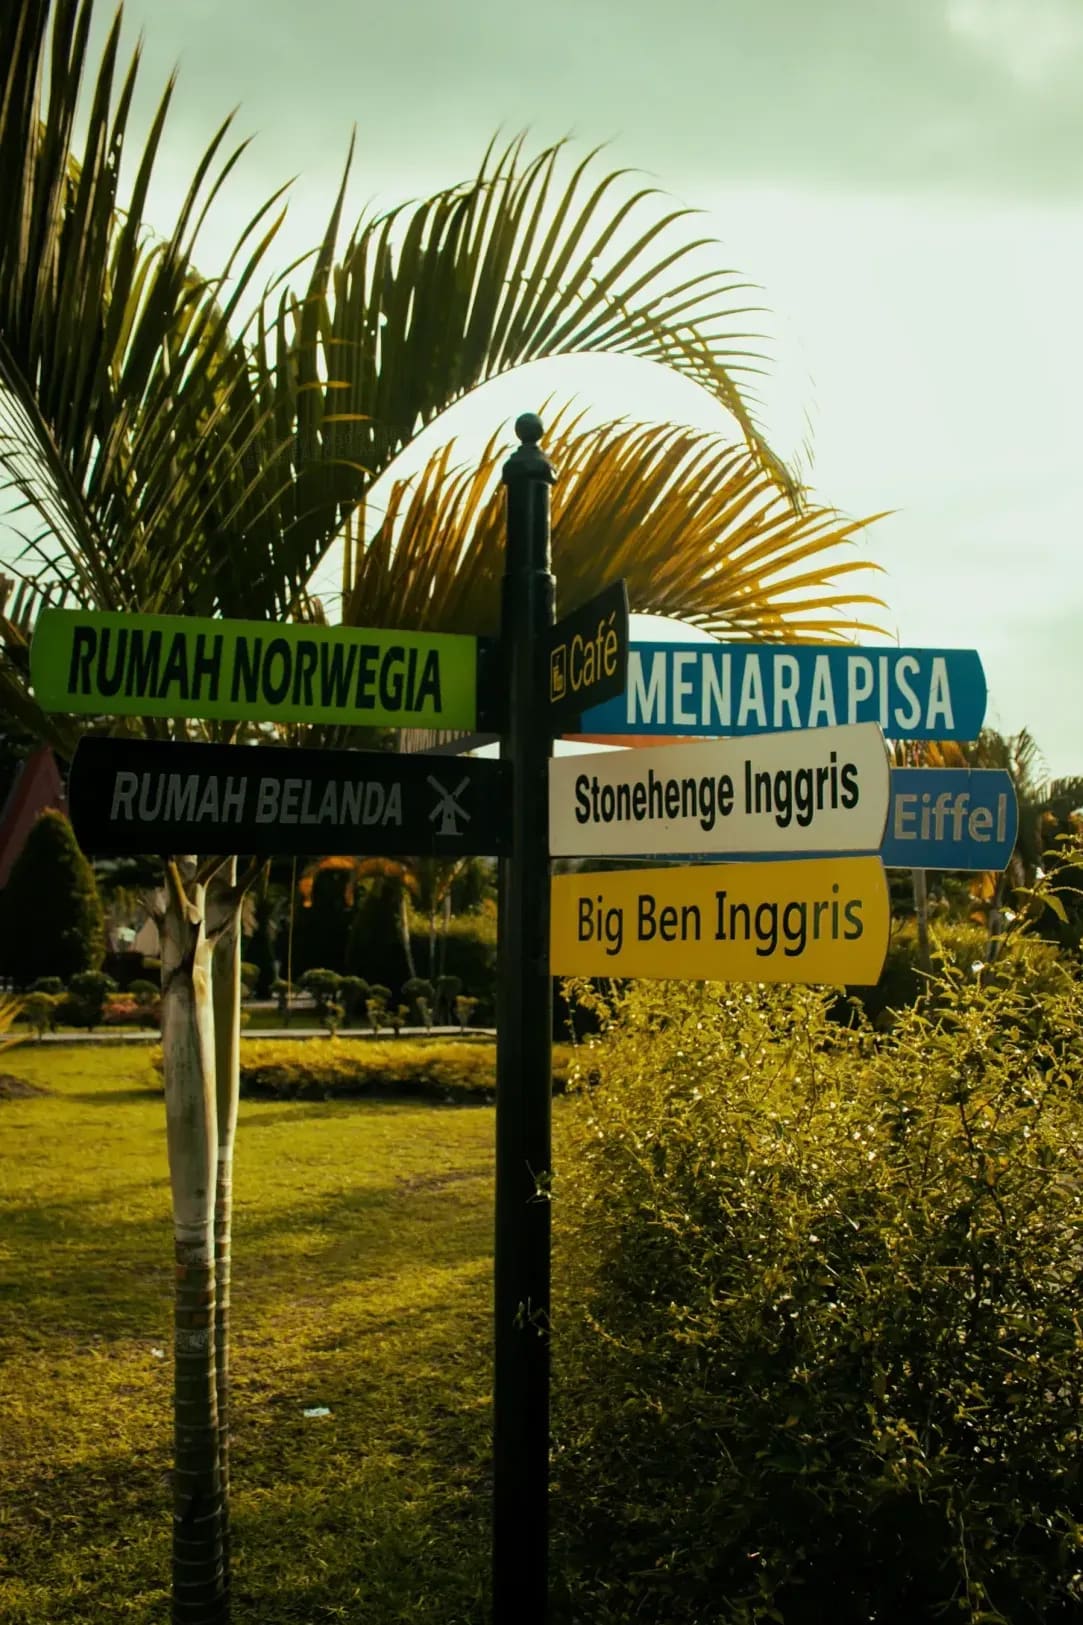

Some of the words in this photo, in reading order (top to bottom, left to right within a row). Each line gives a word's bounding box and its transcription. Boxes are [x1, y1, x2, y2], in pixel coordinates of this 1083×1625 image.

[67, 626, 223, 701] RUMAH
[231, 636, 443, 713] NORWEGIA
[570, 610, 618, 692] Café
[626, 650, 838, 728] MENARA
[847, 656, 955, 730] PISA
[110, 771, 248, 822] RUMAH
[255, 778, 401, 825] BELANDA
[574, 769, 735, 832] Stonehenge
[745, 751, 860, 828] Inggris
[894, 792, 1008, 842] Eiffel
[577, 895, 624, 956] Big
[637, 894, 701, 942] Ben
[715, 883, 864, 957] Inggris
